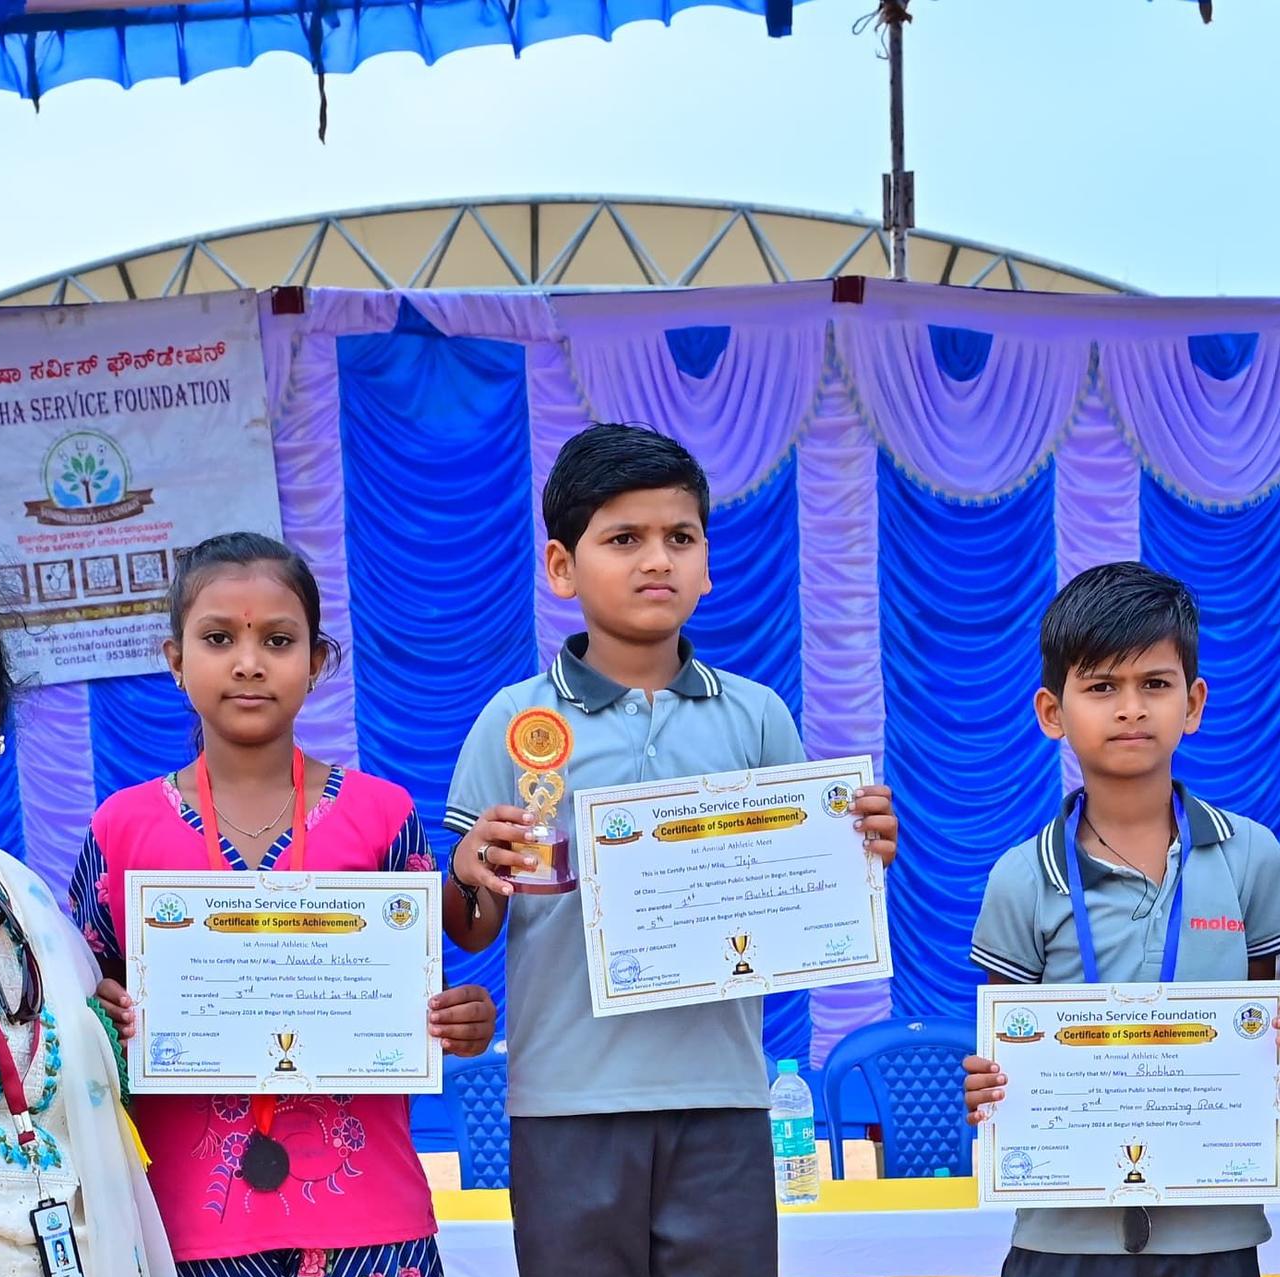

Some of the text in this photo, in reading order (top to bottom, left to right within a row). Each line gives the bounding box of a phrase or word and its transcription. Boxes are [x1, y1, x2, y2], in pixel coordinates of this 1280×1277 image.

[31, 389, 109, 422] SERVICE
[115, 379, 231, 413] FOUNDATION
[60, 530, 95, 541] passion
[98, 526, 116, 536] with
[119, 521, 173, 534] compassion
[52, 543, 84, 552] service
[88, 538, 96, 548] of
[98, 533, 167, 547] underprivileged
[55, 654, 96, 666] Contact
[652, 792, 805, 819] Vonisha Service Foundation
[661, 812, 799, 836] Certificate of Sports Achievement
[728, 840, 754, 850] Athletic
[756, 838, 772, 847] Meet
[205, 898, 366, 910] Vonisha Service Foundation
[648, 903, 672, 912] awarded
[213, 918, 358, 928] Certificate of Sports Achievement
[1190, 914, 1246, 933] molex
[281, 940, 308, 949] Athletic
[311, 941, 328, 949] Meet
[1056, 1009, 1217, 1022] Vonisha Service Foundation
[1063, 1028, 1209, 1040] Certificate of Sports Achievement
[1104, 1052, 1130, 1060] Annual
[1131, 1052, 1159, 1060] Athletic
[1161, 1052, 1179, 1060] Meet
[1136, 1063, 1185, 1077] Shobhan
[1146, 1099, 1192, 1115] Running
[1048, 1115, 1063, 1129] 5th
